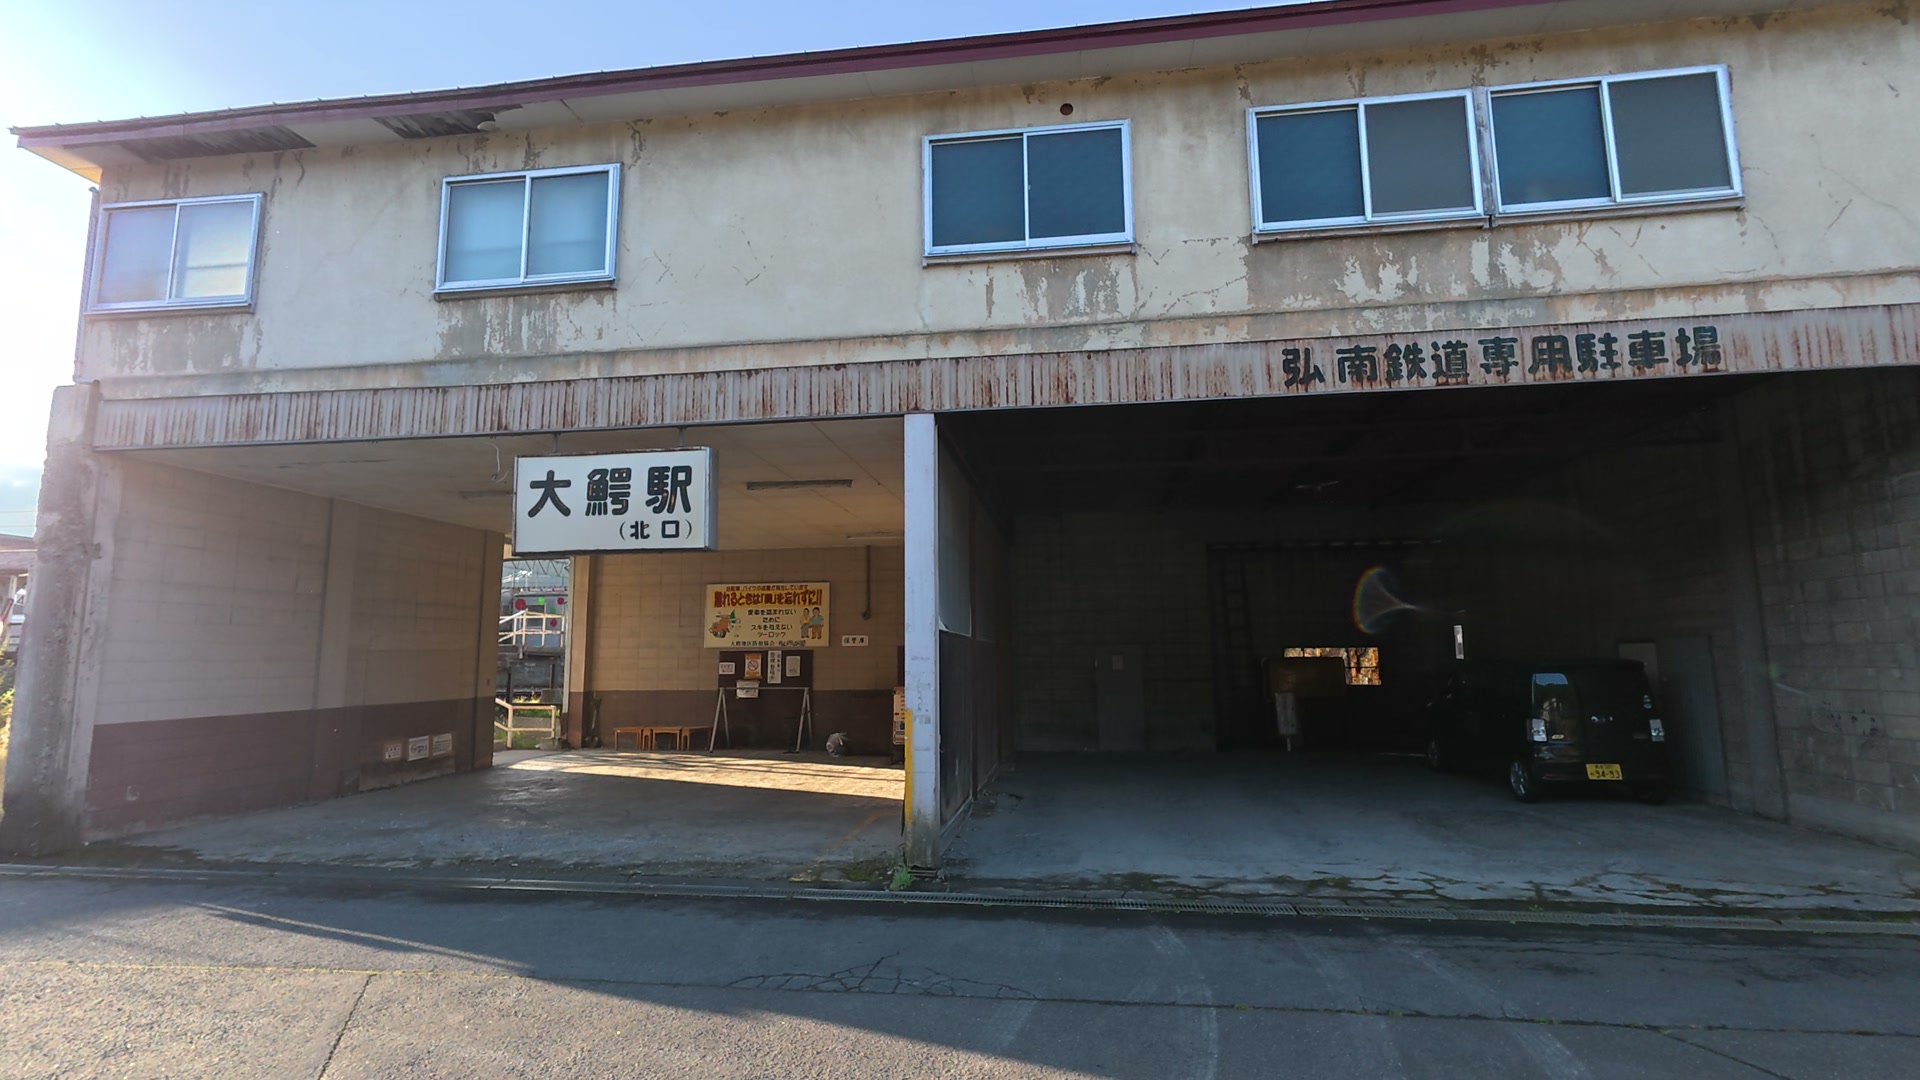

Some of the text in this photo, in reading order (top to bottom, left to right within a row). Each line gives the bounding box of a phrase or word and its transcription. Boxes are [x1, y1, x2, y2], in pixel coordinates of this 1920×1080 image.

[1282, 326, 1722, 387] 弘南鉄道専用駐車場
[527, 465, 692, 518] 大鰐駅
